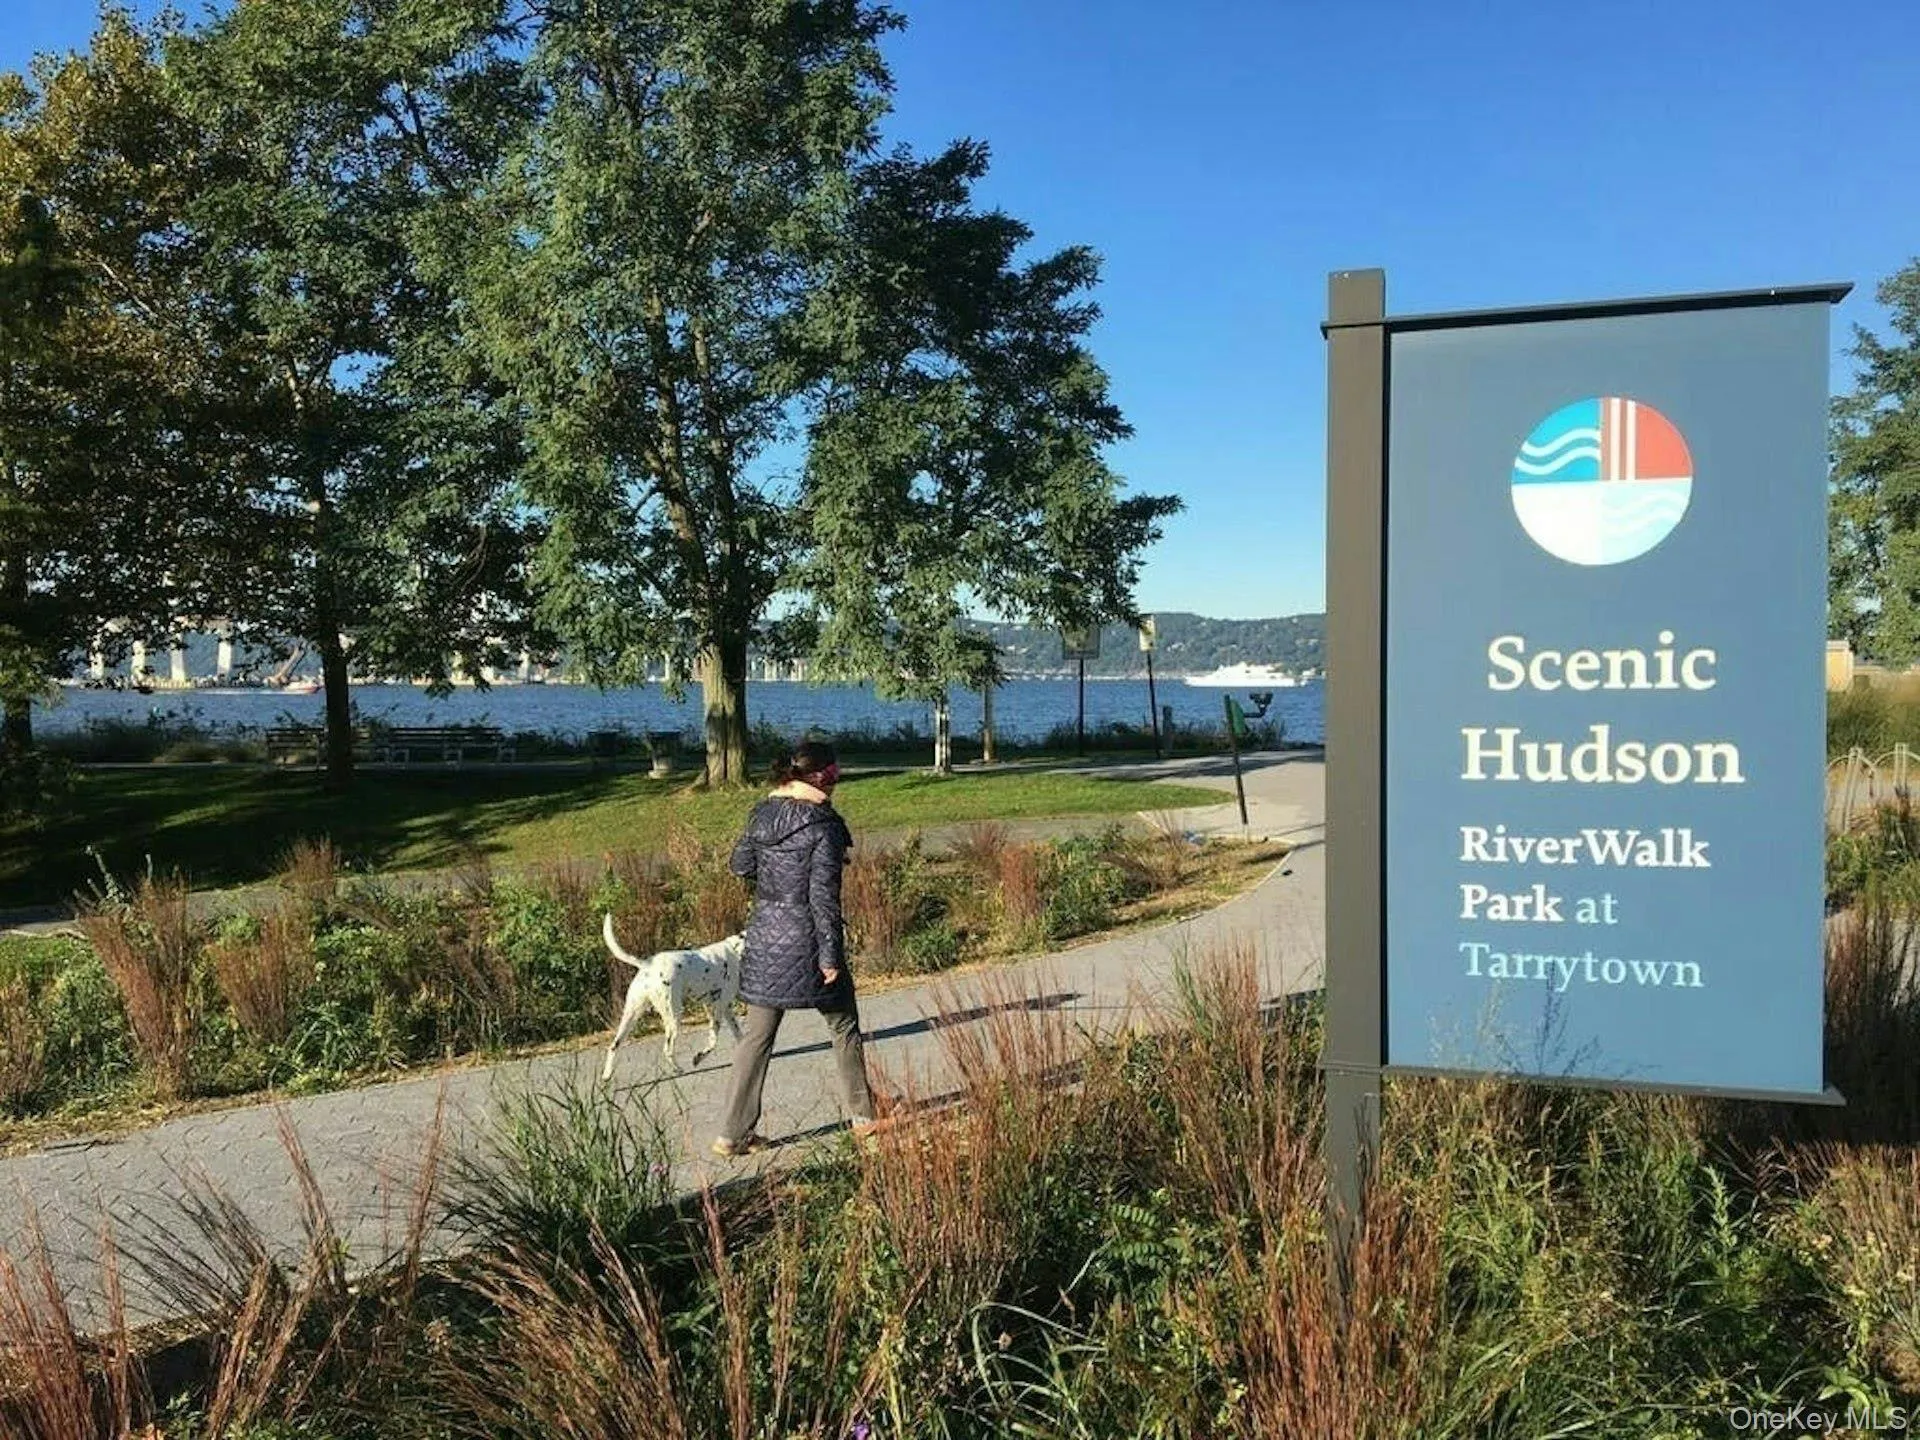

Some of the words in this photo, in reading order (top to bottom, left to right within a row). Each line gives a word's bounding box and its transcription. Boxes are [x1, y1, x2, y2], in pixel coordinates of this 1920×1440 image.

[1487, 631, 1717, 691] Scenic
[1461, 723, 1745, 785] Hudson
[1459, 825, 1711, 868] RiverWalk
[1459, 884, 1565, 923] Park
[1576, 892, 1619, 925] at
[1459, 941, 1705, 993] Tarrytown
